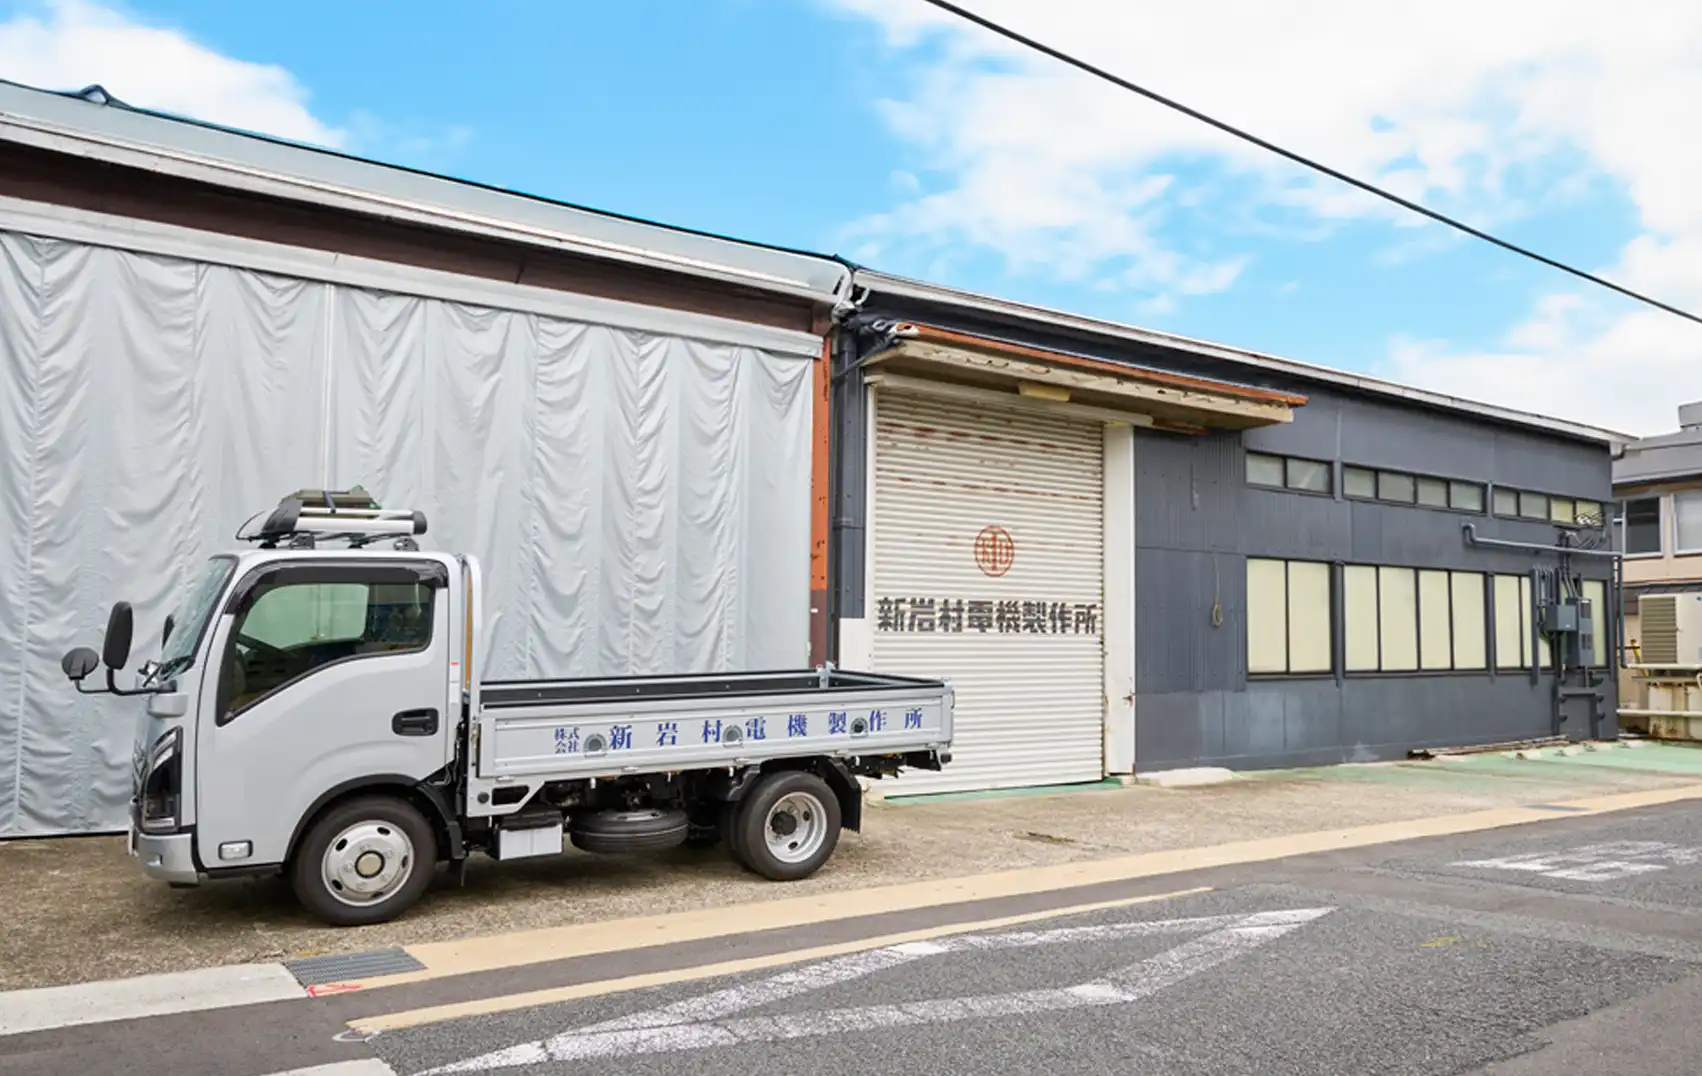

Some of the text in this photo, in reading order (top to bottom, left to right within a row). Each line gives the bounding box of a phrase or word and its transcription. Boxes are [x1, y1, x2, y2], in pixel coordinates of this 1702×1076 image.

[877, 597, 1098, 634] 新岩村電機製作所
